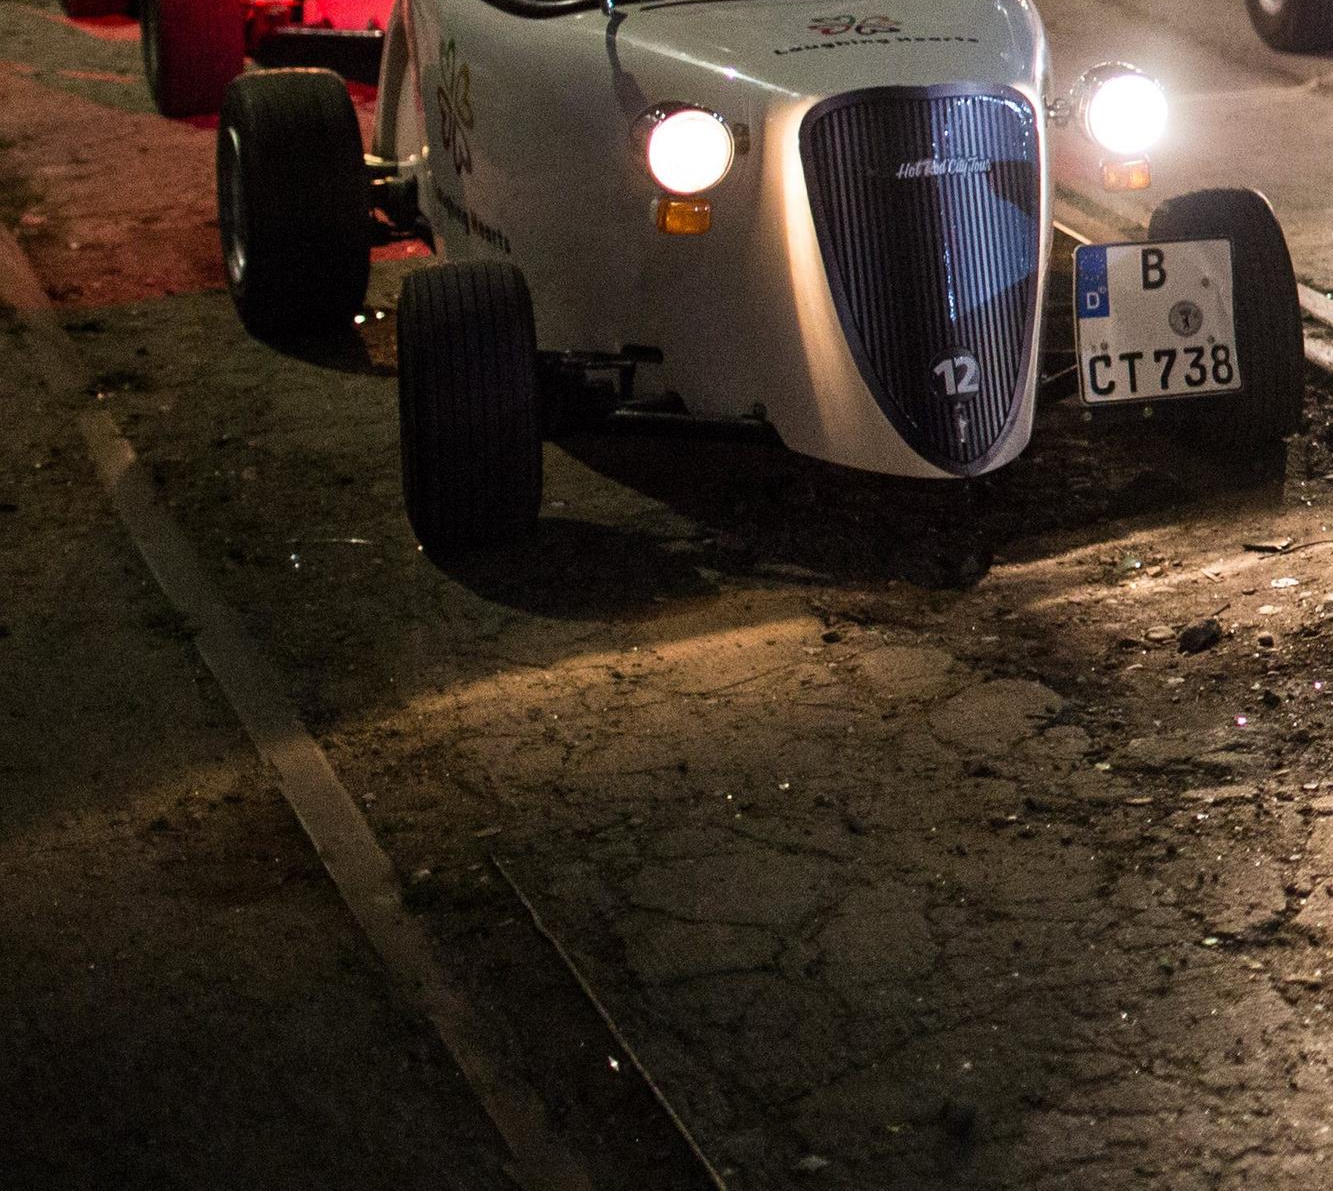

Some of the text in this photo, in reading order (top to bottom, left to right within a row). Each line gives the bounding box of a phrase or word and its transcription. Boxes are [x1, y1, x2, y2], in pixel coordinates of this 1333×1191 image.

[1141, 248, 1167, 291] B
[1086, 292, 1100, 310] D
[932, 355, 980, 396] 12
[1088, 344, 1234, 396] CT 738
